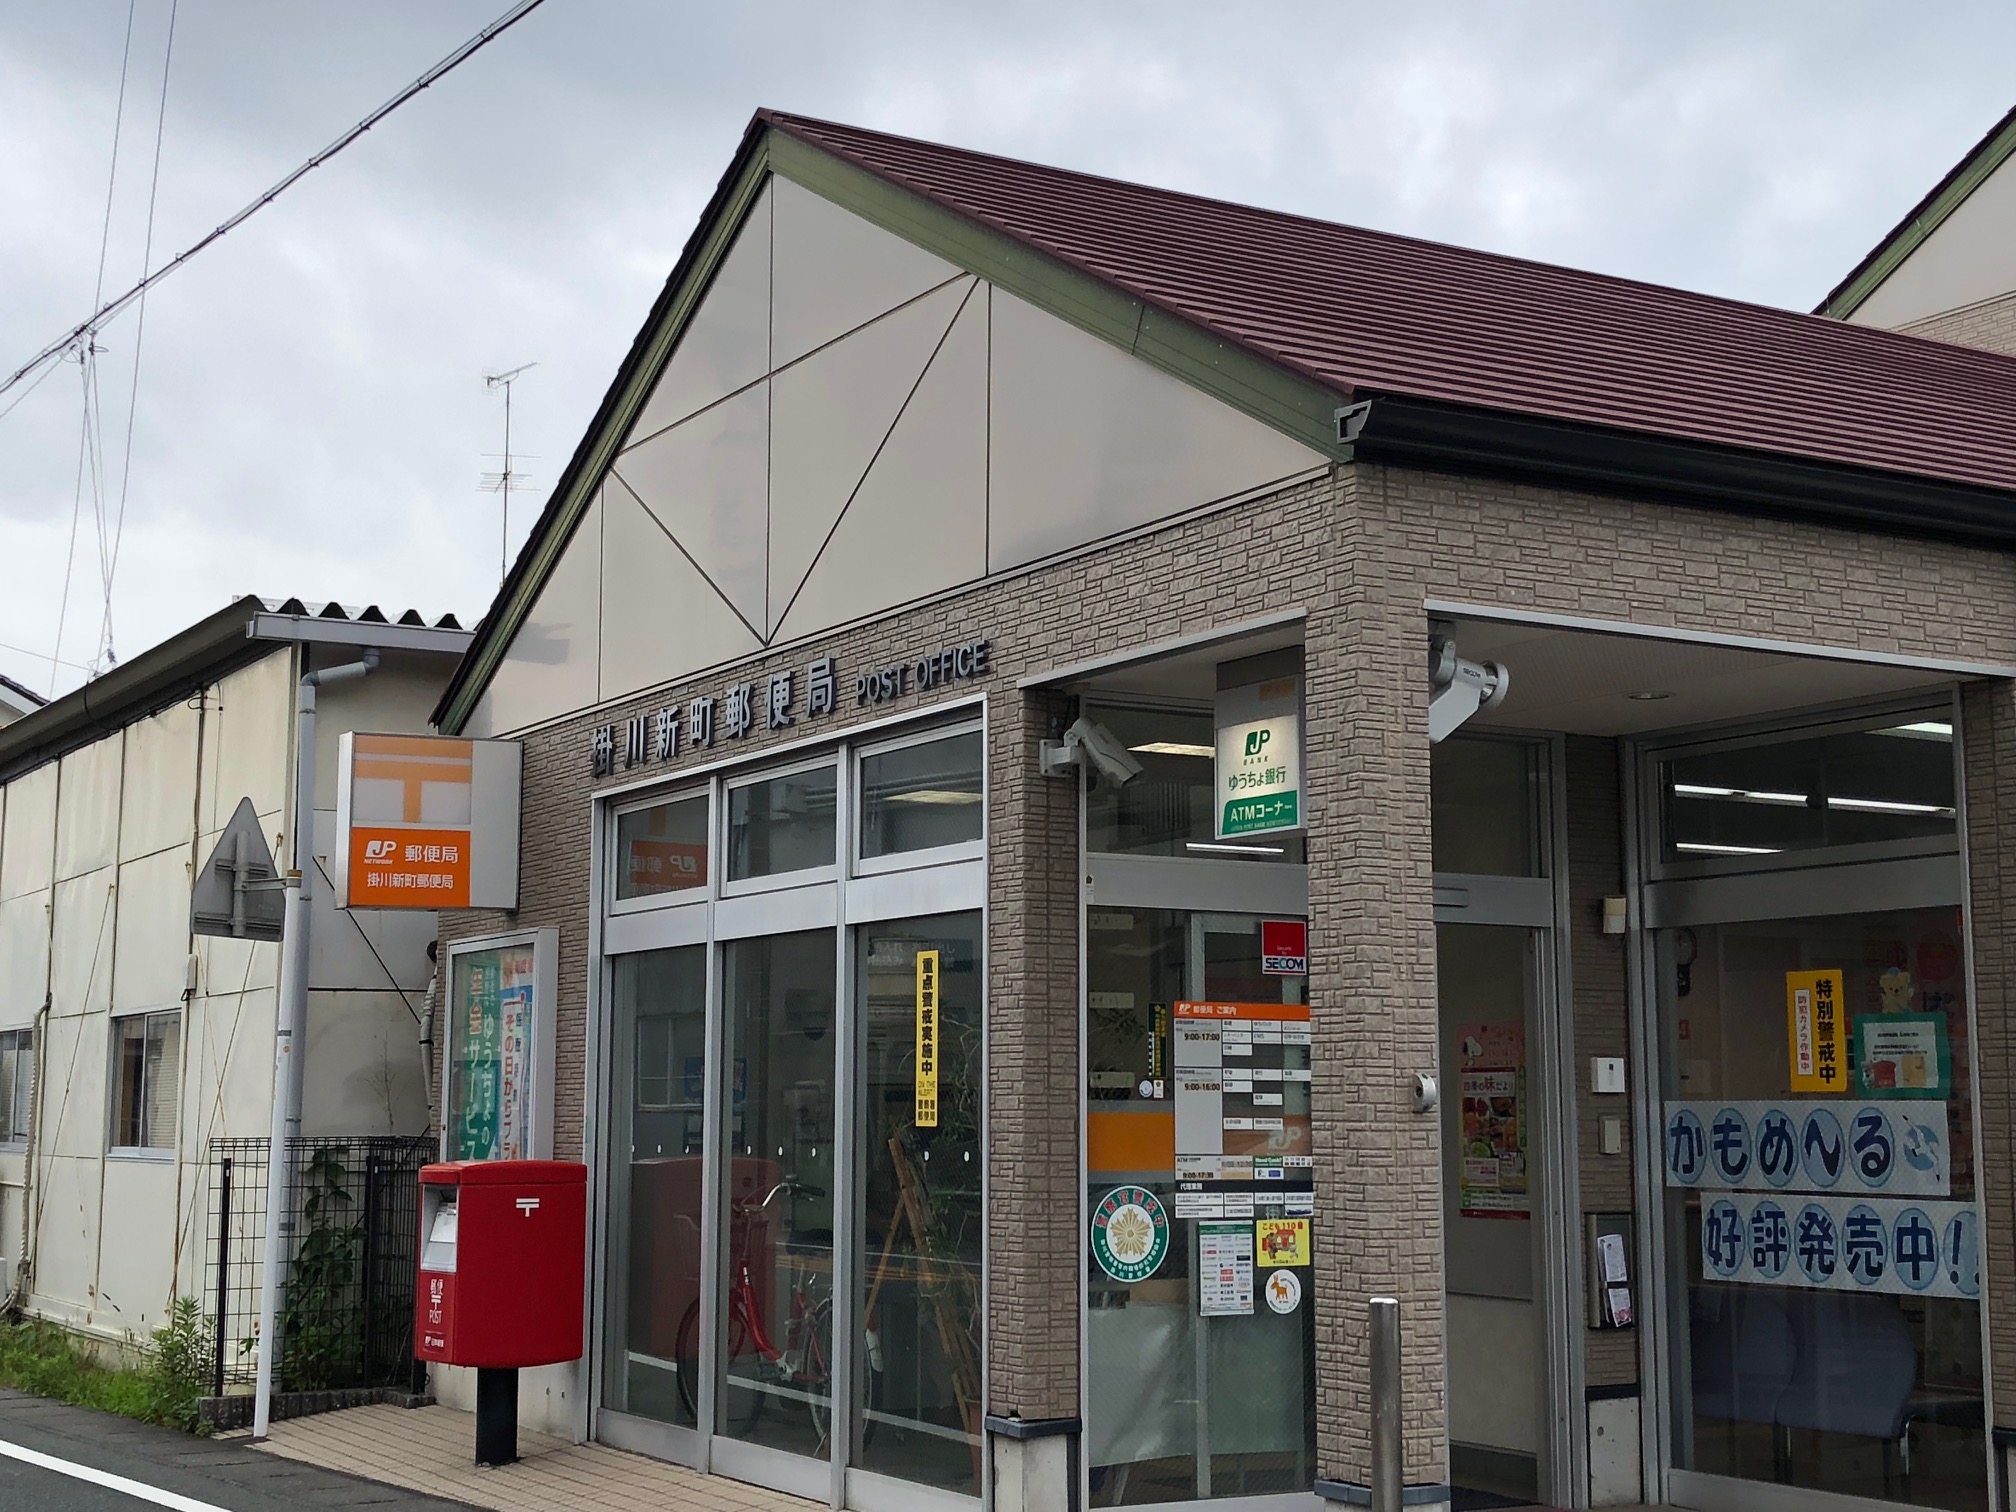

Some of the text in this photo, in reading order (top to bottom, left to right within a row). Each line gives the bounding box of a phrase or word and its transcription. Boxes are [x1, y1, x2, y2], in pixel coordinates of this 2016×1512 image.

[591, 640, 990, 778] 掛川新町郵便局 POST OFFICE
[1245, 730, 1270, 757] JP
[1243, 755, 1269, 766] BANK
[1229, 766, 1286, 791] ゆうちょ銀行
[366, 840, 458, 863] JP 郵便局
[367, 872, 454, 889] 掛川新町郵便局
[1265, 957, 1304, 970] SECOM
[921, 957, 933, 1076] 重点警戒実施中
[1798, 995, 1809, 1071] 防犯カメラ作動中
[1816, 979, 1835, 1084] 特別警戒中
